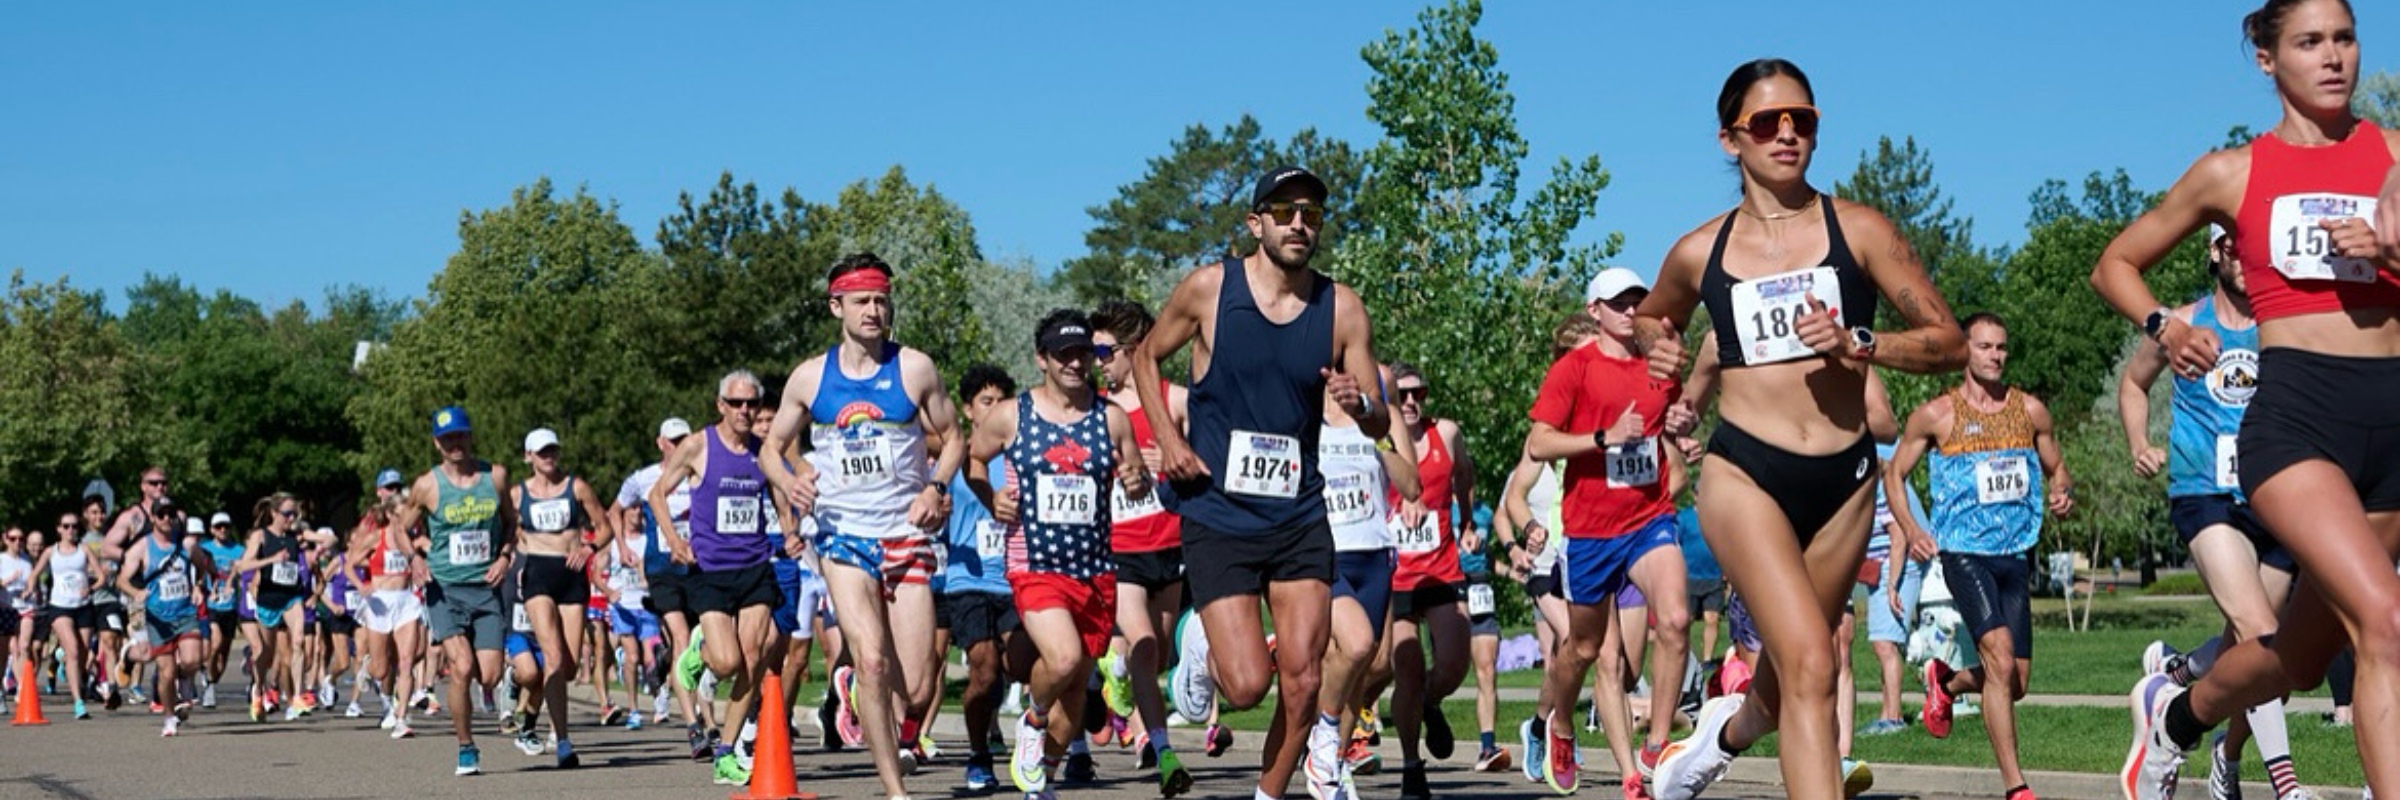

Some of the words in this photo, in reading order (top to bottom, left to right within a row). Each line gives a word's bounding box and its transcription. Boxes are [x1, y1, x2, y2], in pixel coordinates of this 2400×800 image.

[2287, 224, 2333, 256] 15
[1752, 299, 1827, 341] 184
[841, 454, 885, 476] 1901
[1240, 455, 1292, 481] 1974
[1616, 455, 1653, 476] 1914
[1987, 473, 2024, 493] 1876
[1046, 493, 1088, 512] 1716
[1326, 490, 1365, 513] 1814
[725, 509, 754, 525] 1537
[986, 533, 1000, 548] 17
